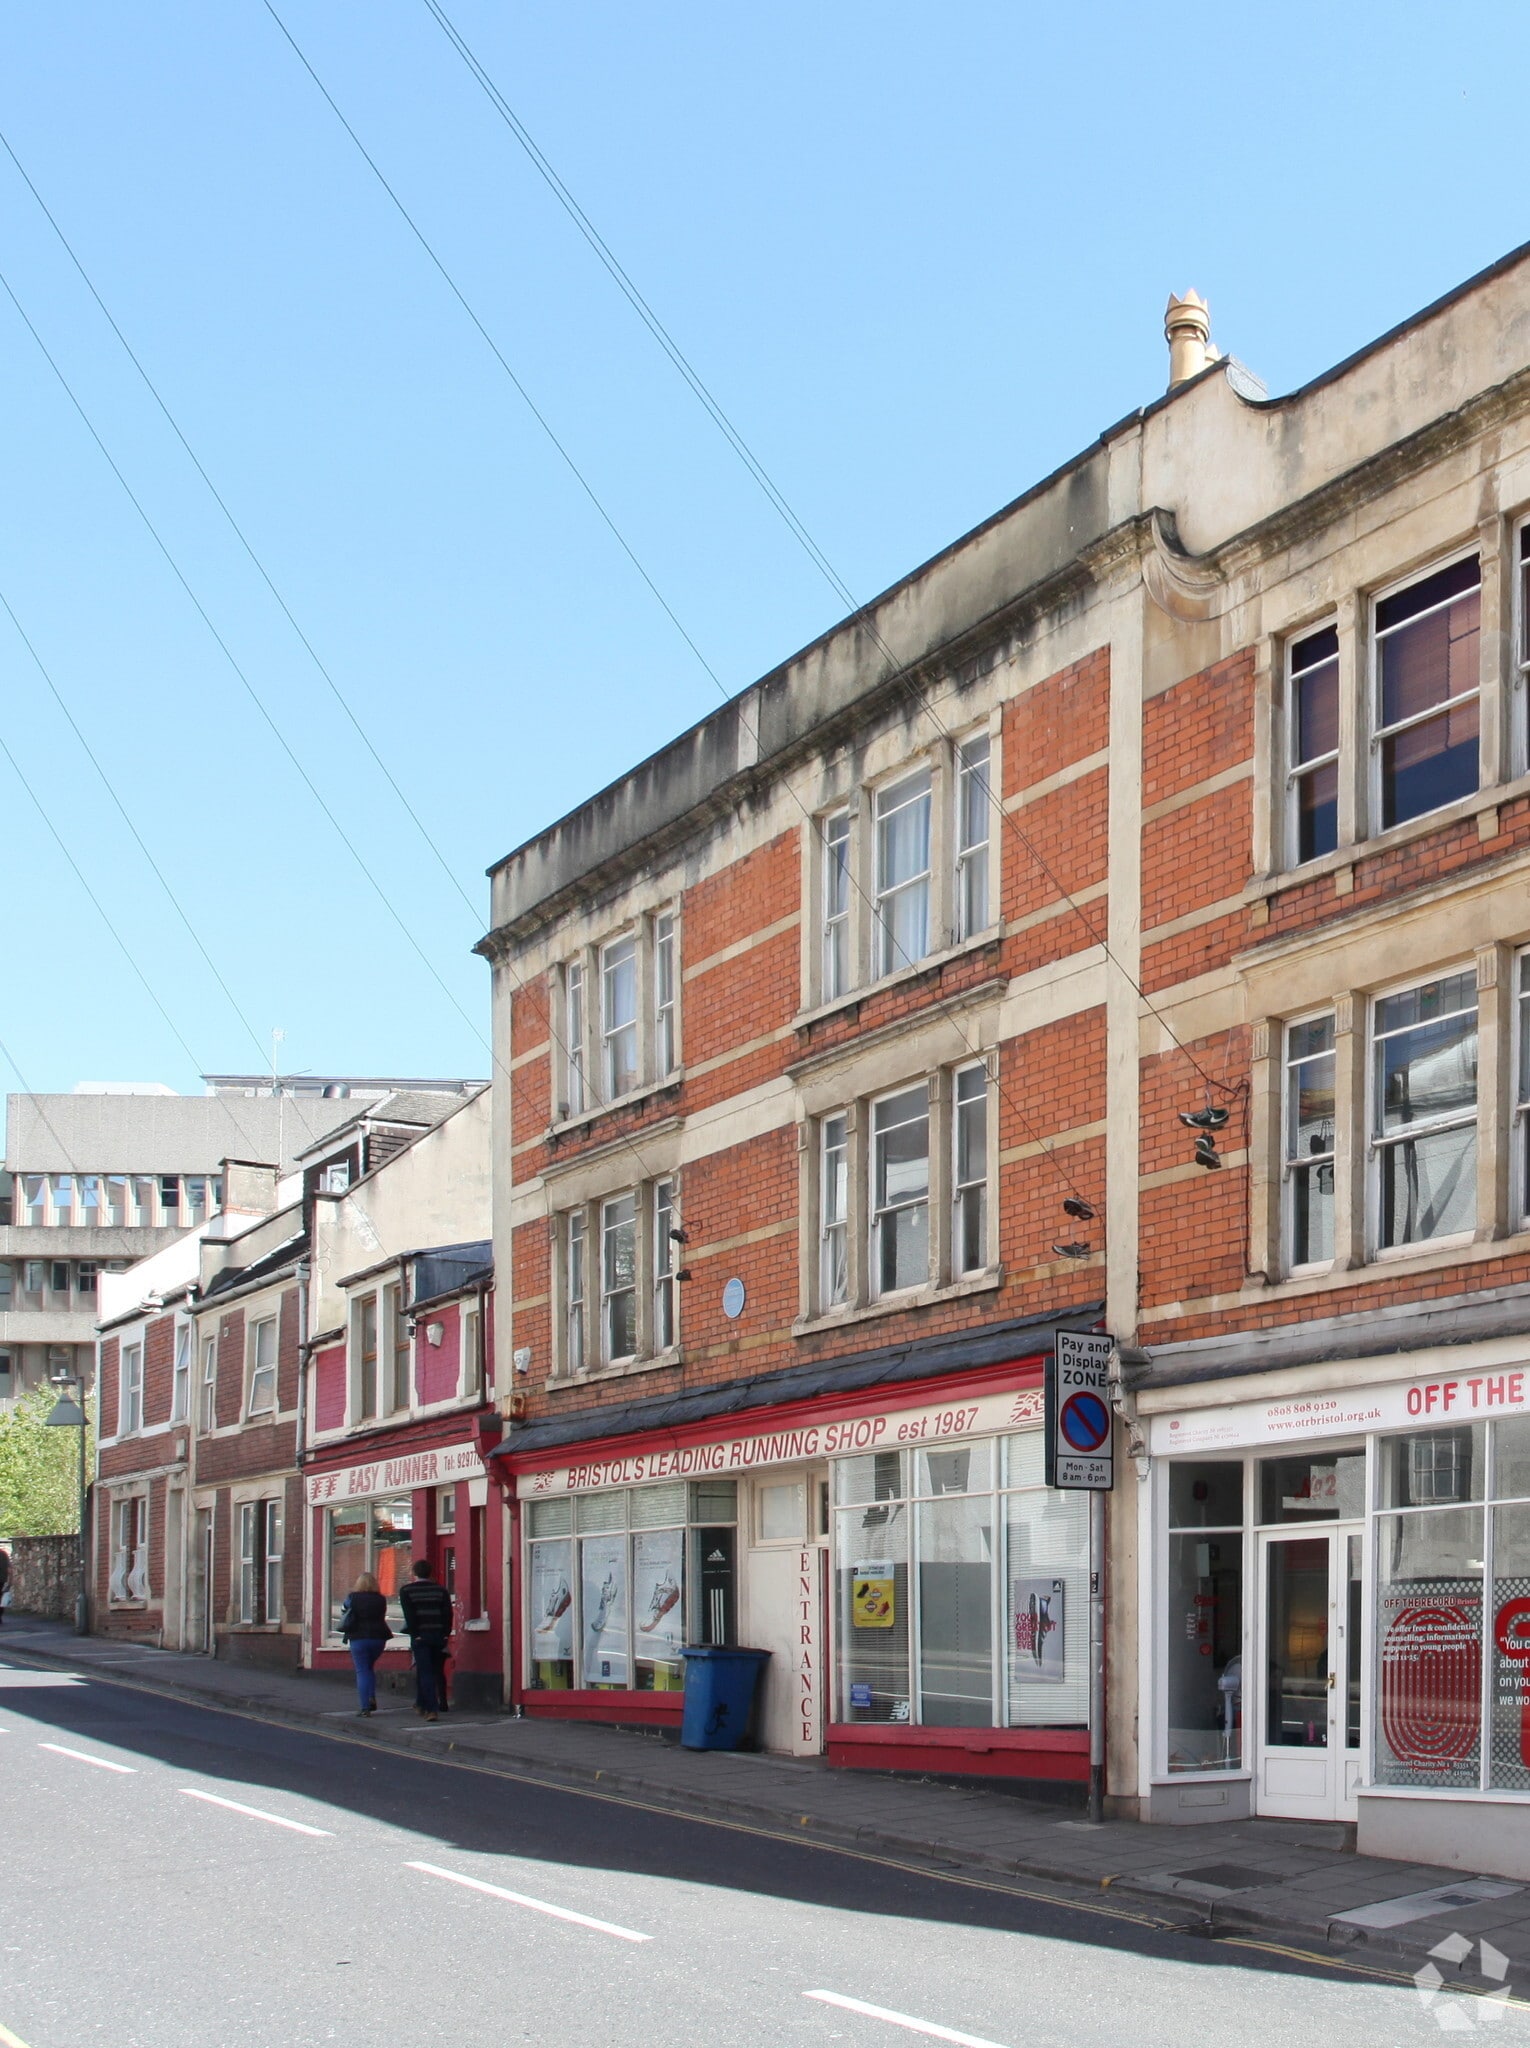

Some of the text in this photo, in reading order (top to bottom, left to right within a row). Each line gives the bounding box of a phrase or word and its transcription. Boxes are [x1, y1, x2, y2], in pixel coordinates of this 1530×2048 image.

[1061, 1336, 1110, 1354] Pay and
[1063, 1353, 1108, 1372] Display
[1063, 1369, 1107, 1387] ZONE
[1407, 1373, 1524, 1415] OFF THE
[1267, 1401, 1337, 1417] 0808 808 9120
[1267, 1407, 1381, 1431] www.otrbristol.org.uk
[566, 1406, 979, 1489] BRISTOL'S LEADING RUNNING SHOP est 1987
[349, 1465, 380, 1494] EASY
[384, 1453, 439, 1488] RUNNER
[1066, 1462, 1083, 1471] Mon
[1090, 1463, 1103, 1472] Sat
[1384, 1599, 1400, 1609] OFF
[1402, 1597, 1420, 1608] THE
[1421, 1596, 1456, 1607] RECORD
[1395, 1624, 1411, 1633] offer
[1412, 1624, 1426, 1632] free
[1427, 1623, 1434, 1631] &
[1434, 1622, 1478, 1632] confidential
[1427, 1633, 1470, 1641] information
[800, 1552, 812, 1741] ENTRANCE
[1419, 1645, 1441, 1653] young
[1442, 1643, 1466, 1652] people
[1500, 1655, 1529, 1668] about
[1500, 1677, 1512, 1687] on
[1499, 1696, 1513, 1705] we
